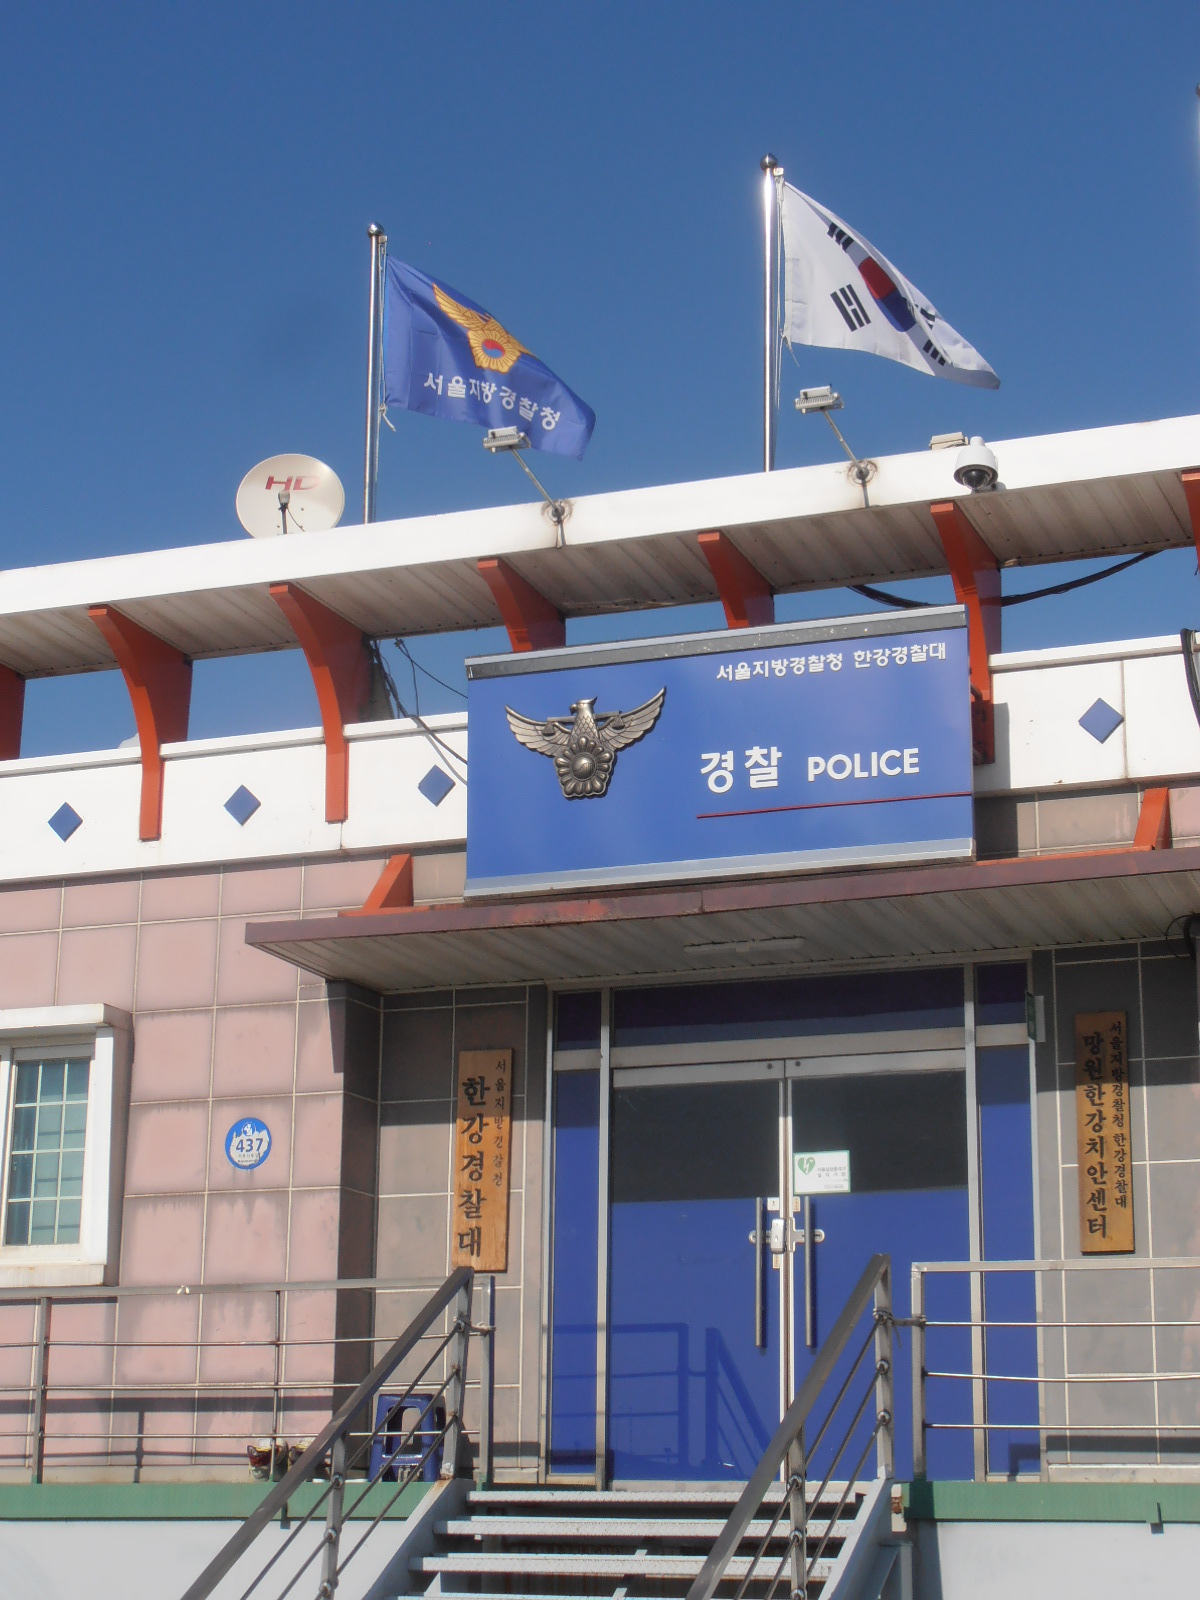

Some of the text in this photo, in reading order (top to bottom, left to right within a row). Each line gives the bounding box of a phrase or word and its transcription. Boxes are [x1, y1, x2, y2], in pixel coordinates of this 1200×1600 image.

[424, 372, 561, 430] 서울지방경찰청
[265, 475, 321, 491] HD
[716, 642, 947, 681] 서울지방경찰청 한강경찰대
[700, 746, 920, 794] 경찰 POLICE
[493, 1059, 507, 1187] 서울지방경찰청
[1109, 1020, 1129, 1209] 서울지방경찰청 한강경찰대
[236, 1137, 264, 1152] 437
[458, 1076, 490, 1257] 한강경찰대
